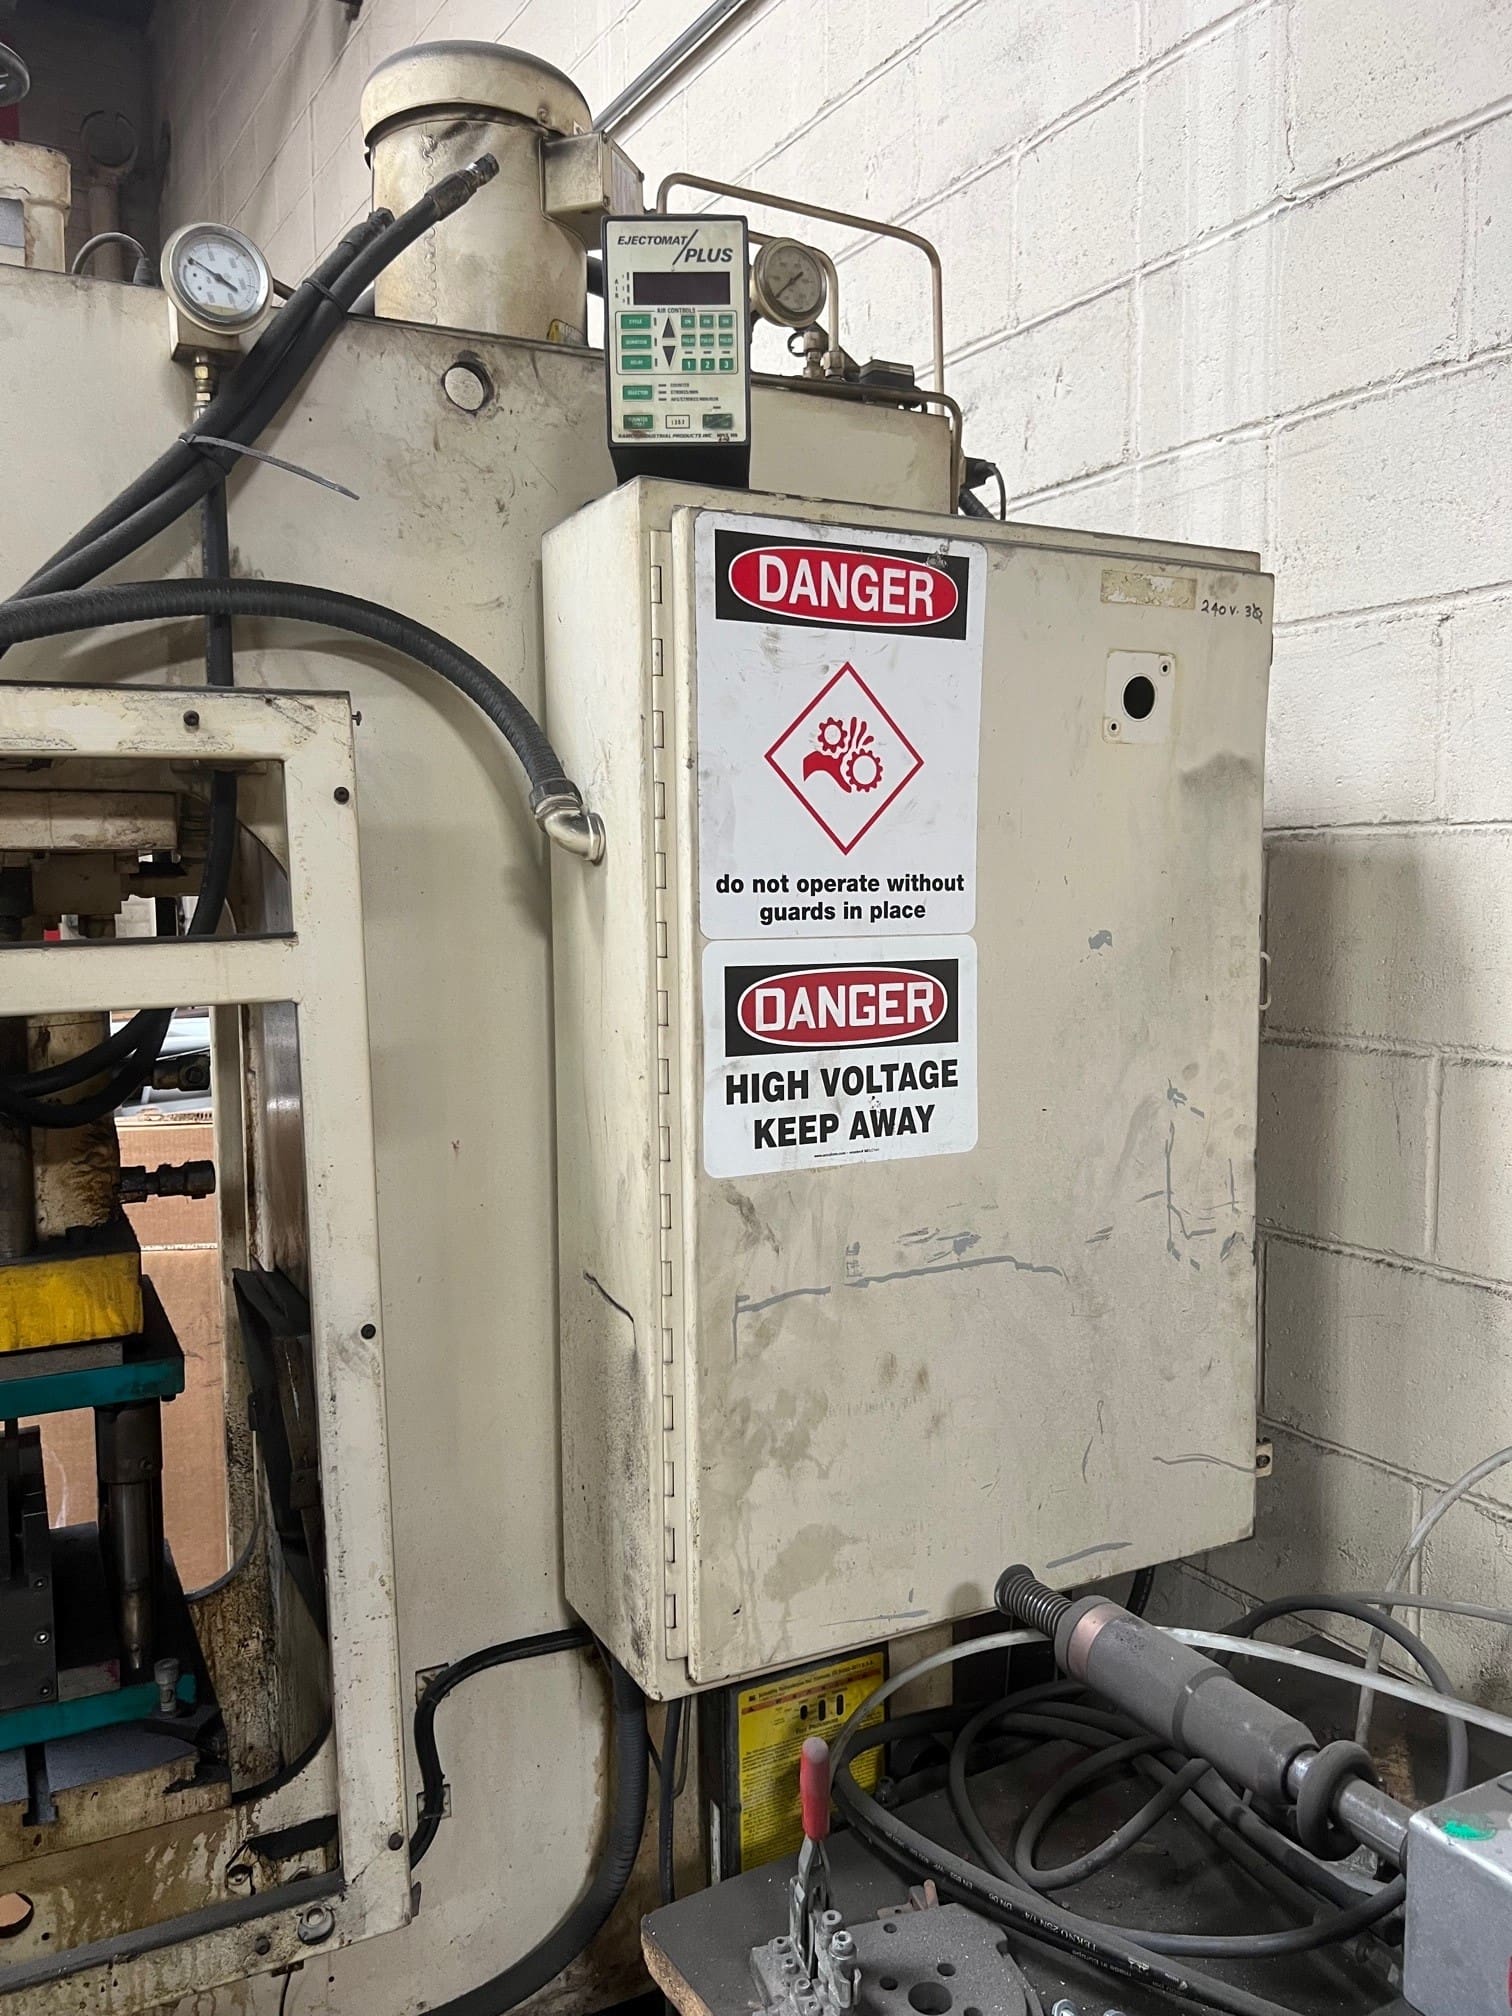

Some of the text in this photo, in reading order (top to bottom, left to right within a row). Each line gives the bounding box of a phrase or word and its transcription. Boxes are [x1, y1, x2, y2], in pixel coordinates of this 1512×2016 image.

[617, 235, 688, 245] EJECTOMAT
[684, 248, 733, 263] PLUS
[759, 554, 934, 617] DANGER
[716, 873, 965, 896] do not operate without
[759, 901, 926, 925] guards in place
[755, 981, 934, 1032] DANGER
[725, 1058, 959, 1105] HIGH VOLTAGE
[753, 1104, 936, 1149] KEEP AWAY
